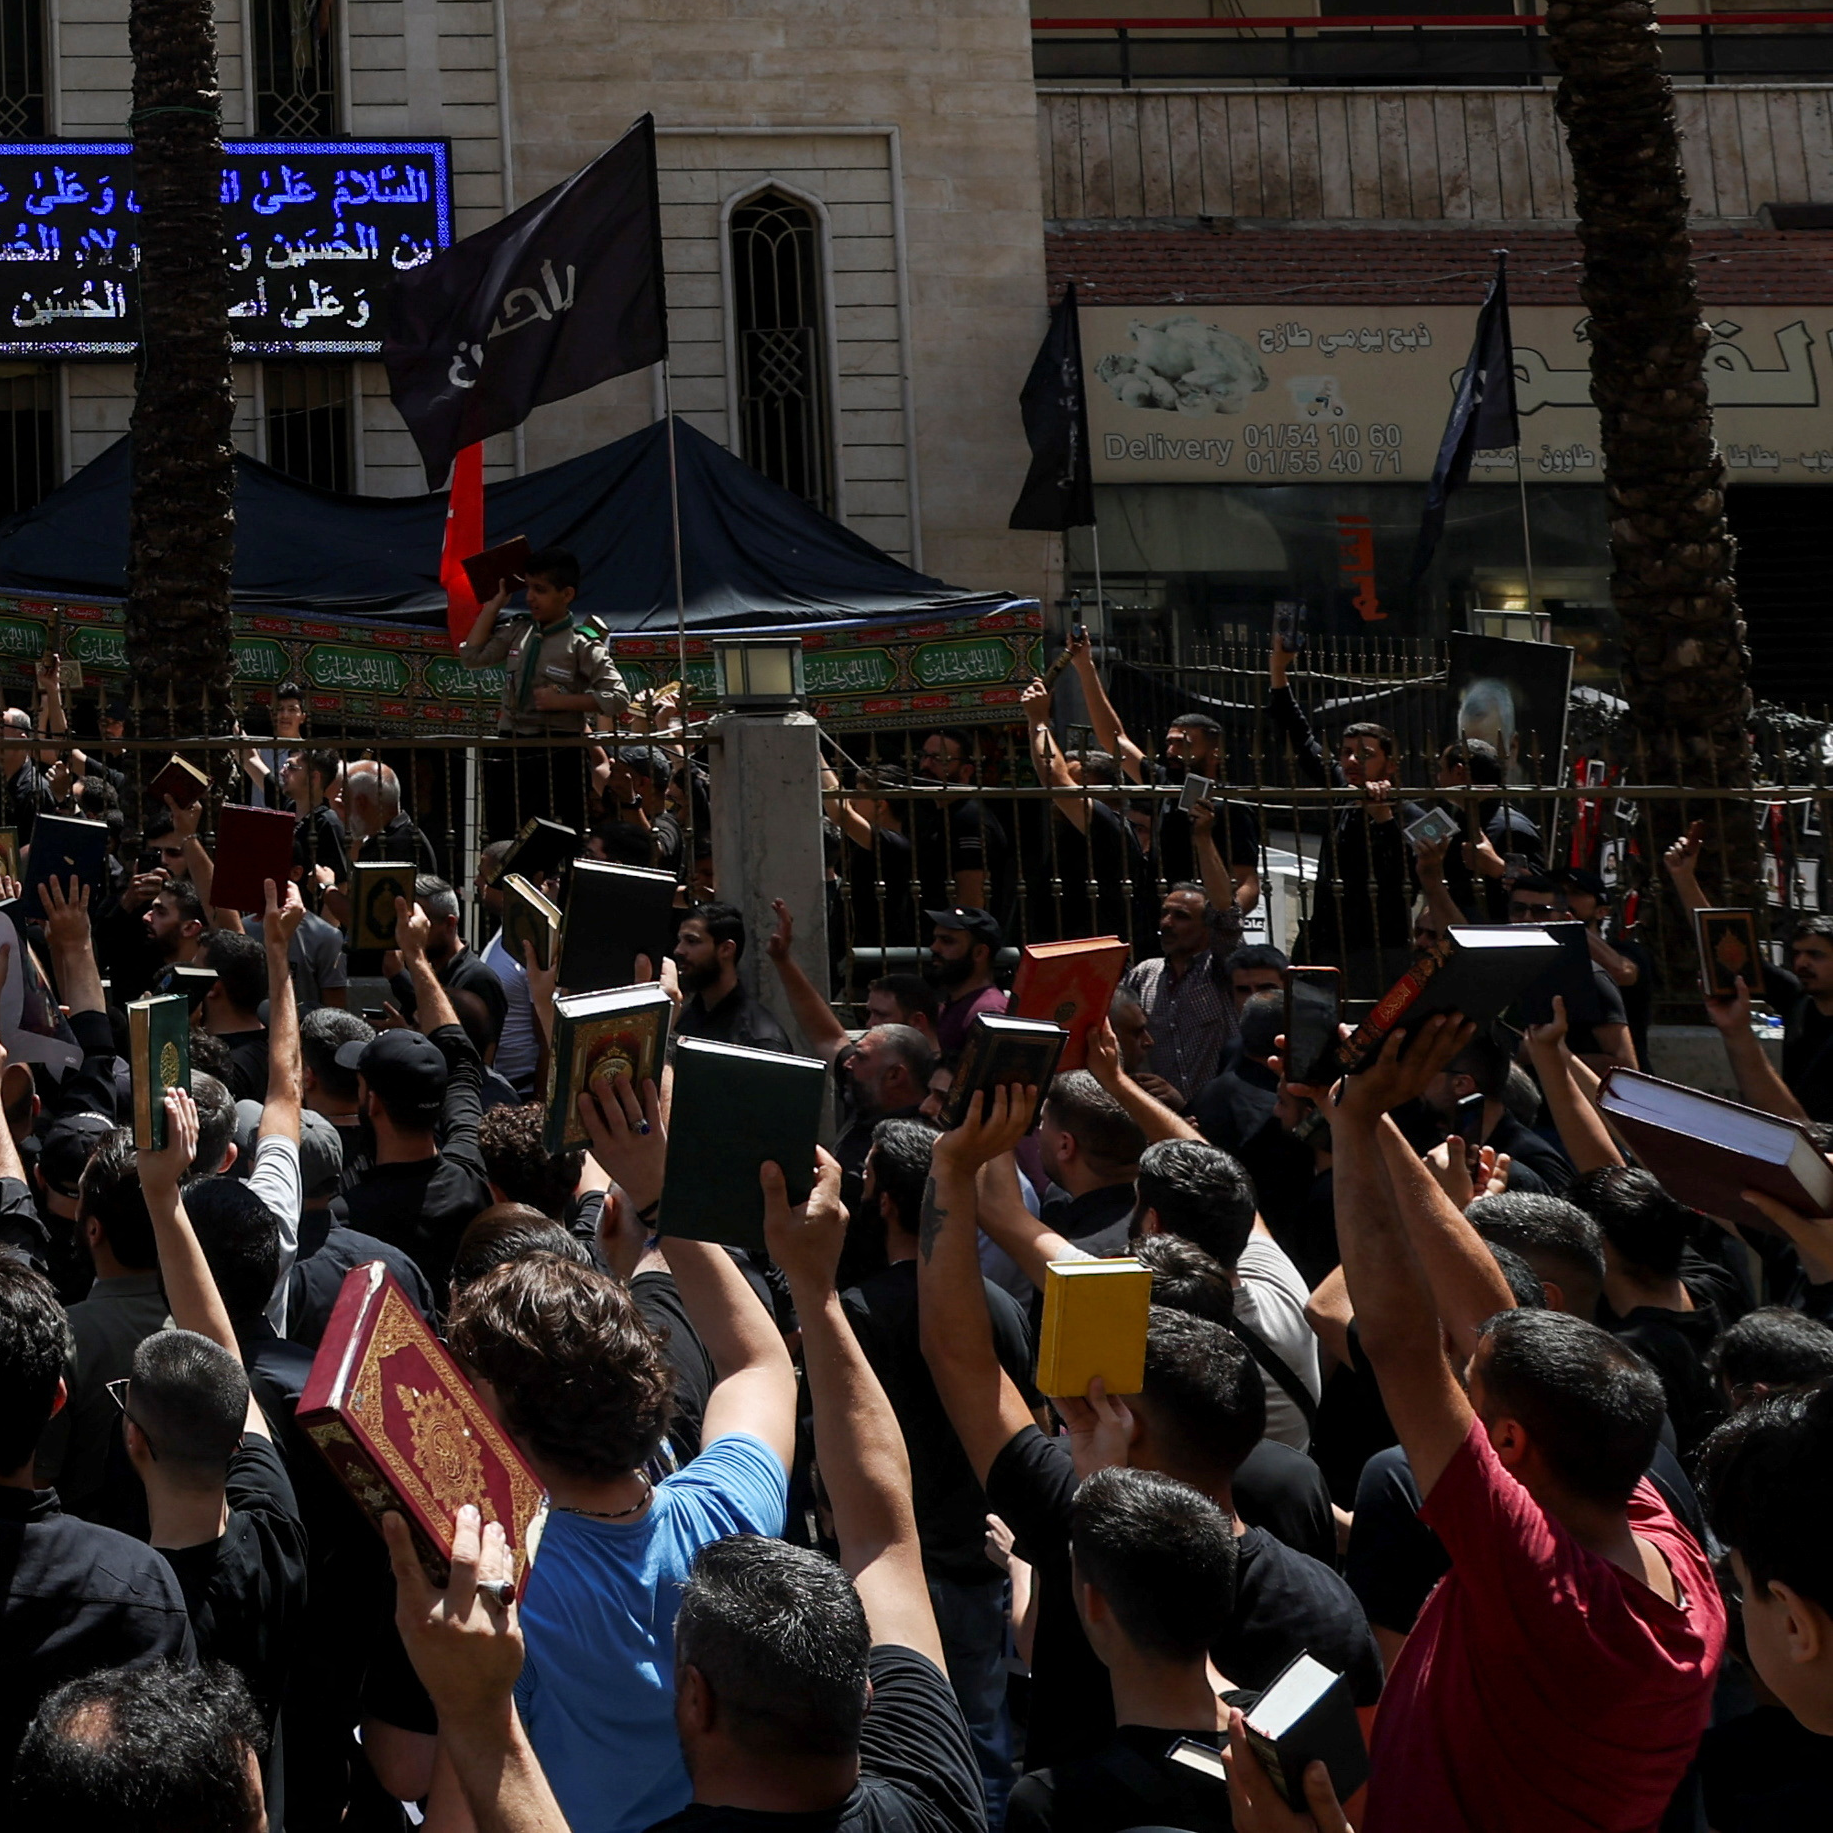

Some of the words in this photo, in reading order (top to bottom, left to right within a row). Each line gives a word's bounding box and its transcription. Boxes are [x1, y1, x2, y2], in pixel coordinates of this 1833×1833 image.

[1318, 326, 1384, 357] يومي
[1104, 432, 1234, 467] Delivery
[1243, 423, 1319, 449] 01/54
[1327, 423, 1360, 448] 10
[1368, 423, 1402, 448] 60
[1245, 449, 1321, 476] 01/55
[1328, 449, 1362, 475] 40
[1372, 449, 1402, 475] 71
